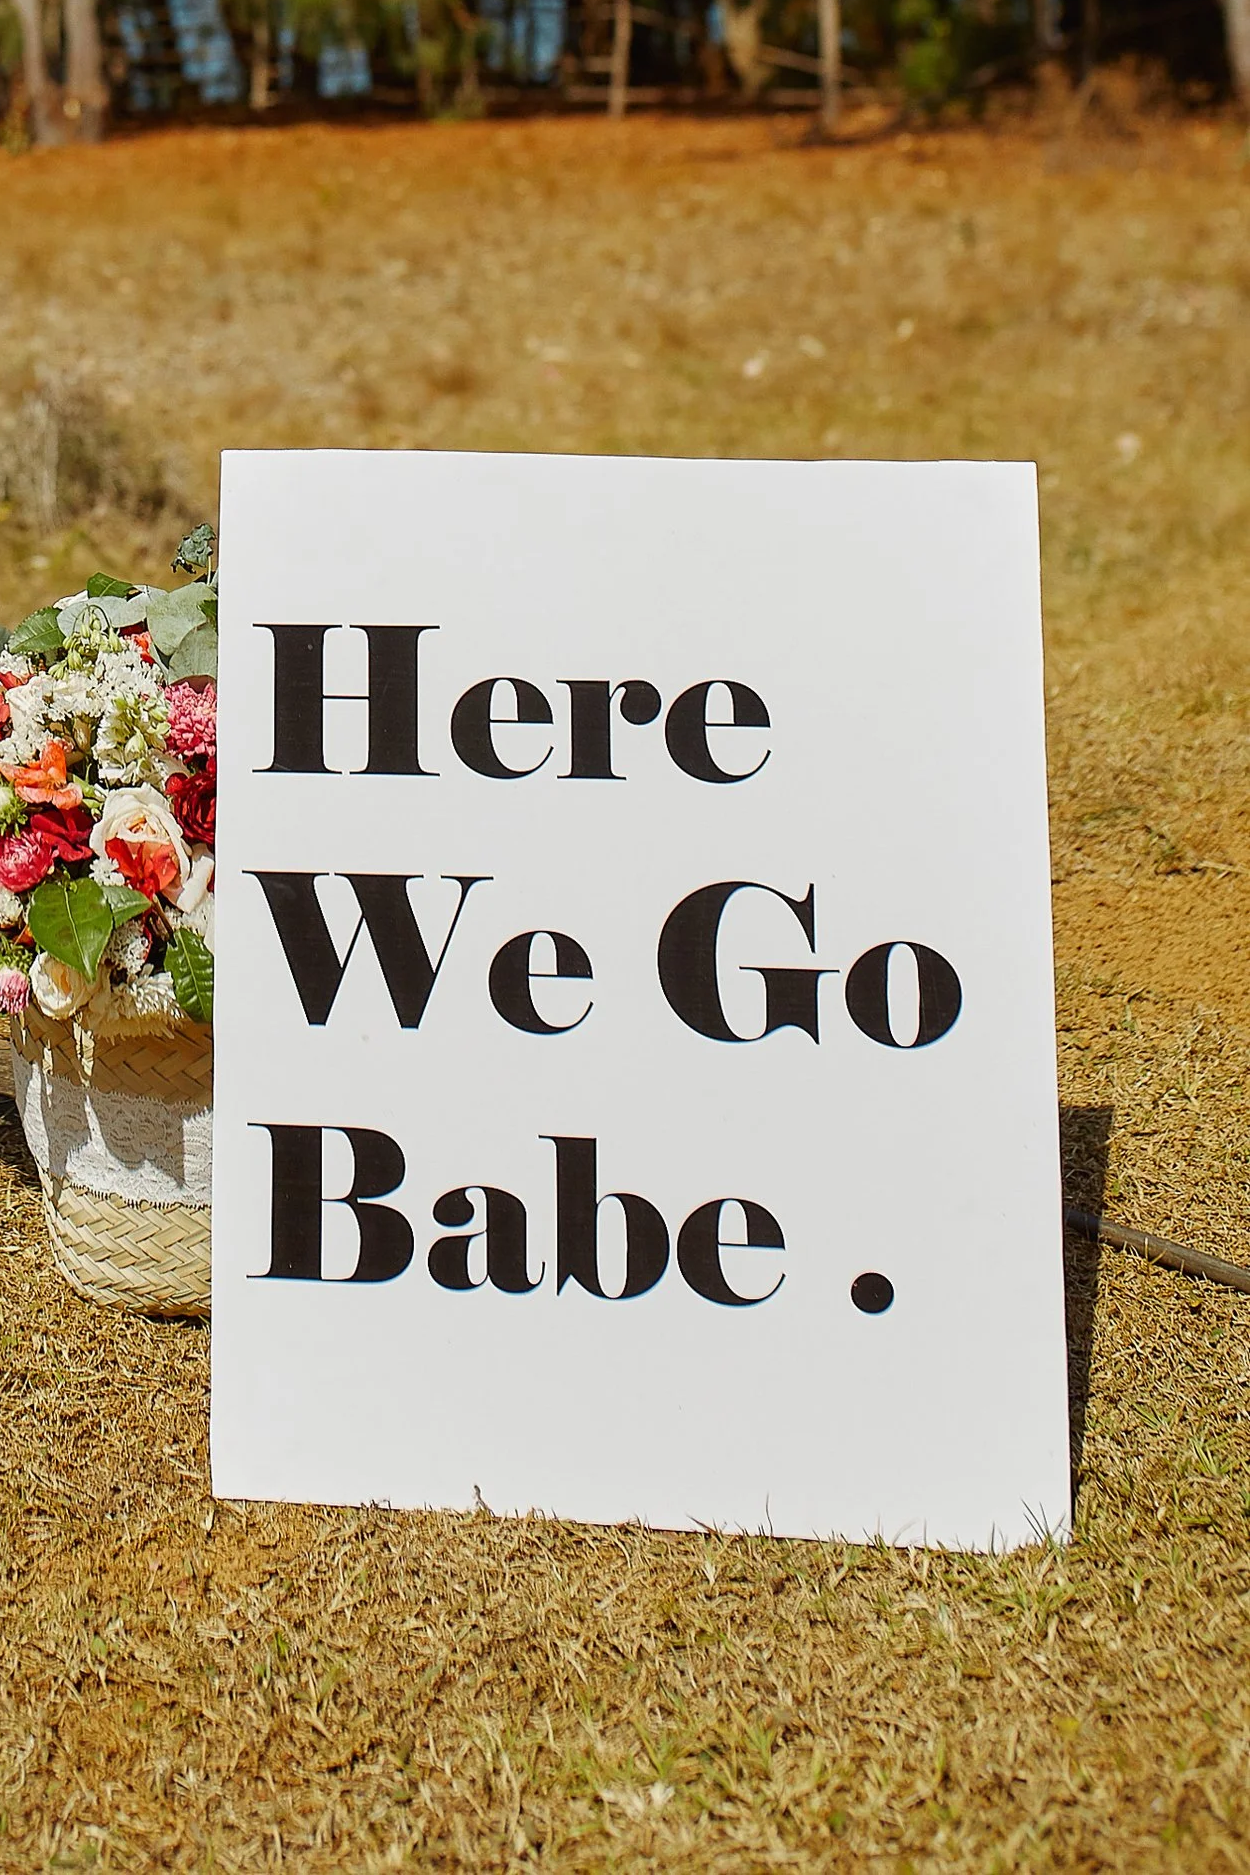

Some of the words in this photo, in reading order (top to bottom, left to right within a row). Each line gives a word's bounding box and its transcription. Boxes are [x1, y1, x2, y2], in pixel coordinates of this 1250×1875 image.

[251, 623, 772, 784] Here
[241, 869, 594, 1036] We
[657, 880, 963, 1049] Go
[245, 1122, 786, 1307] Babe
